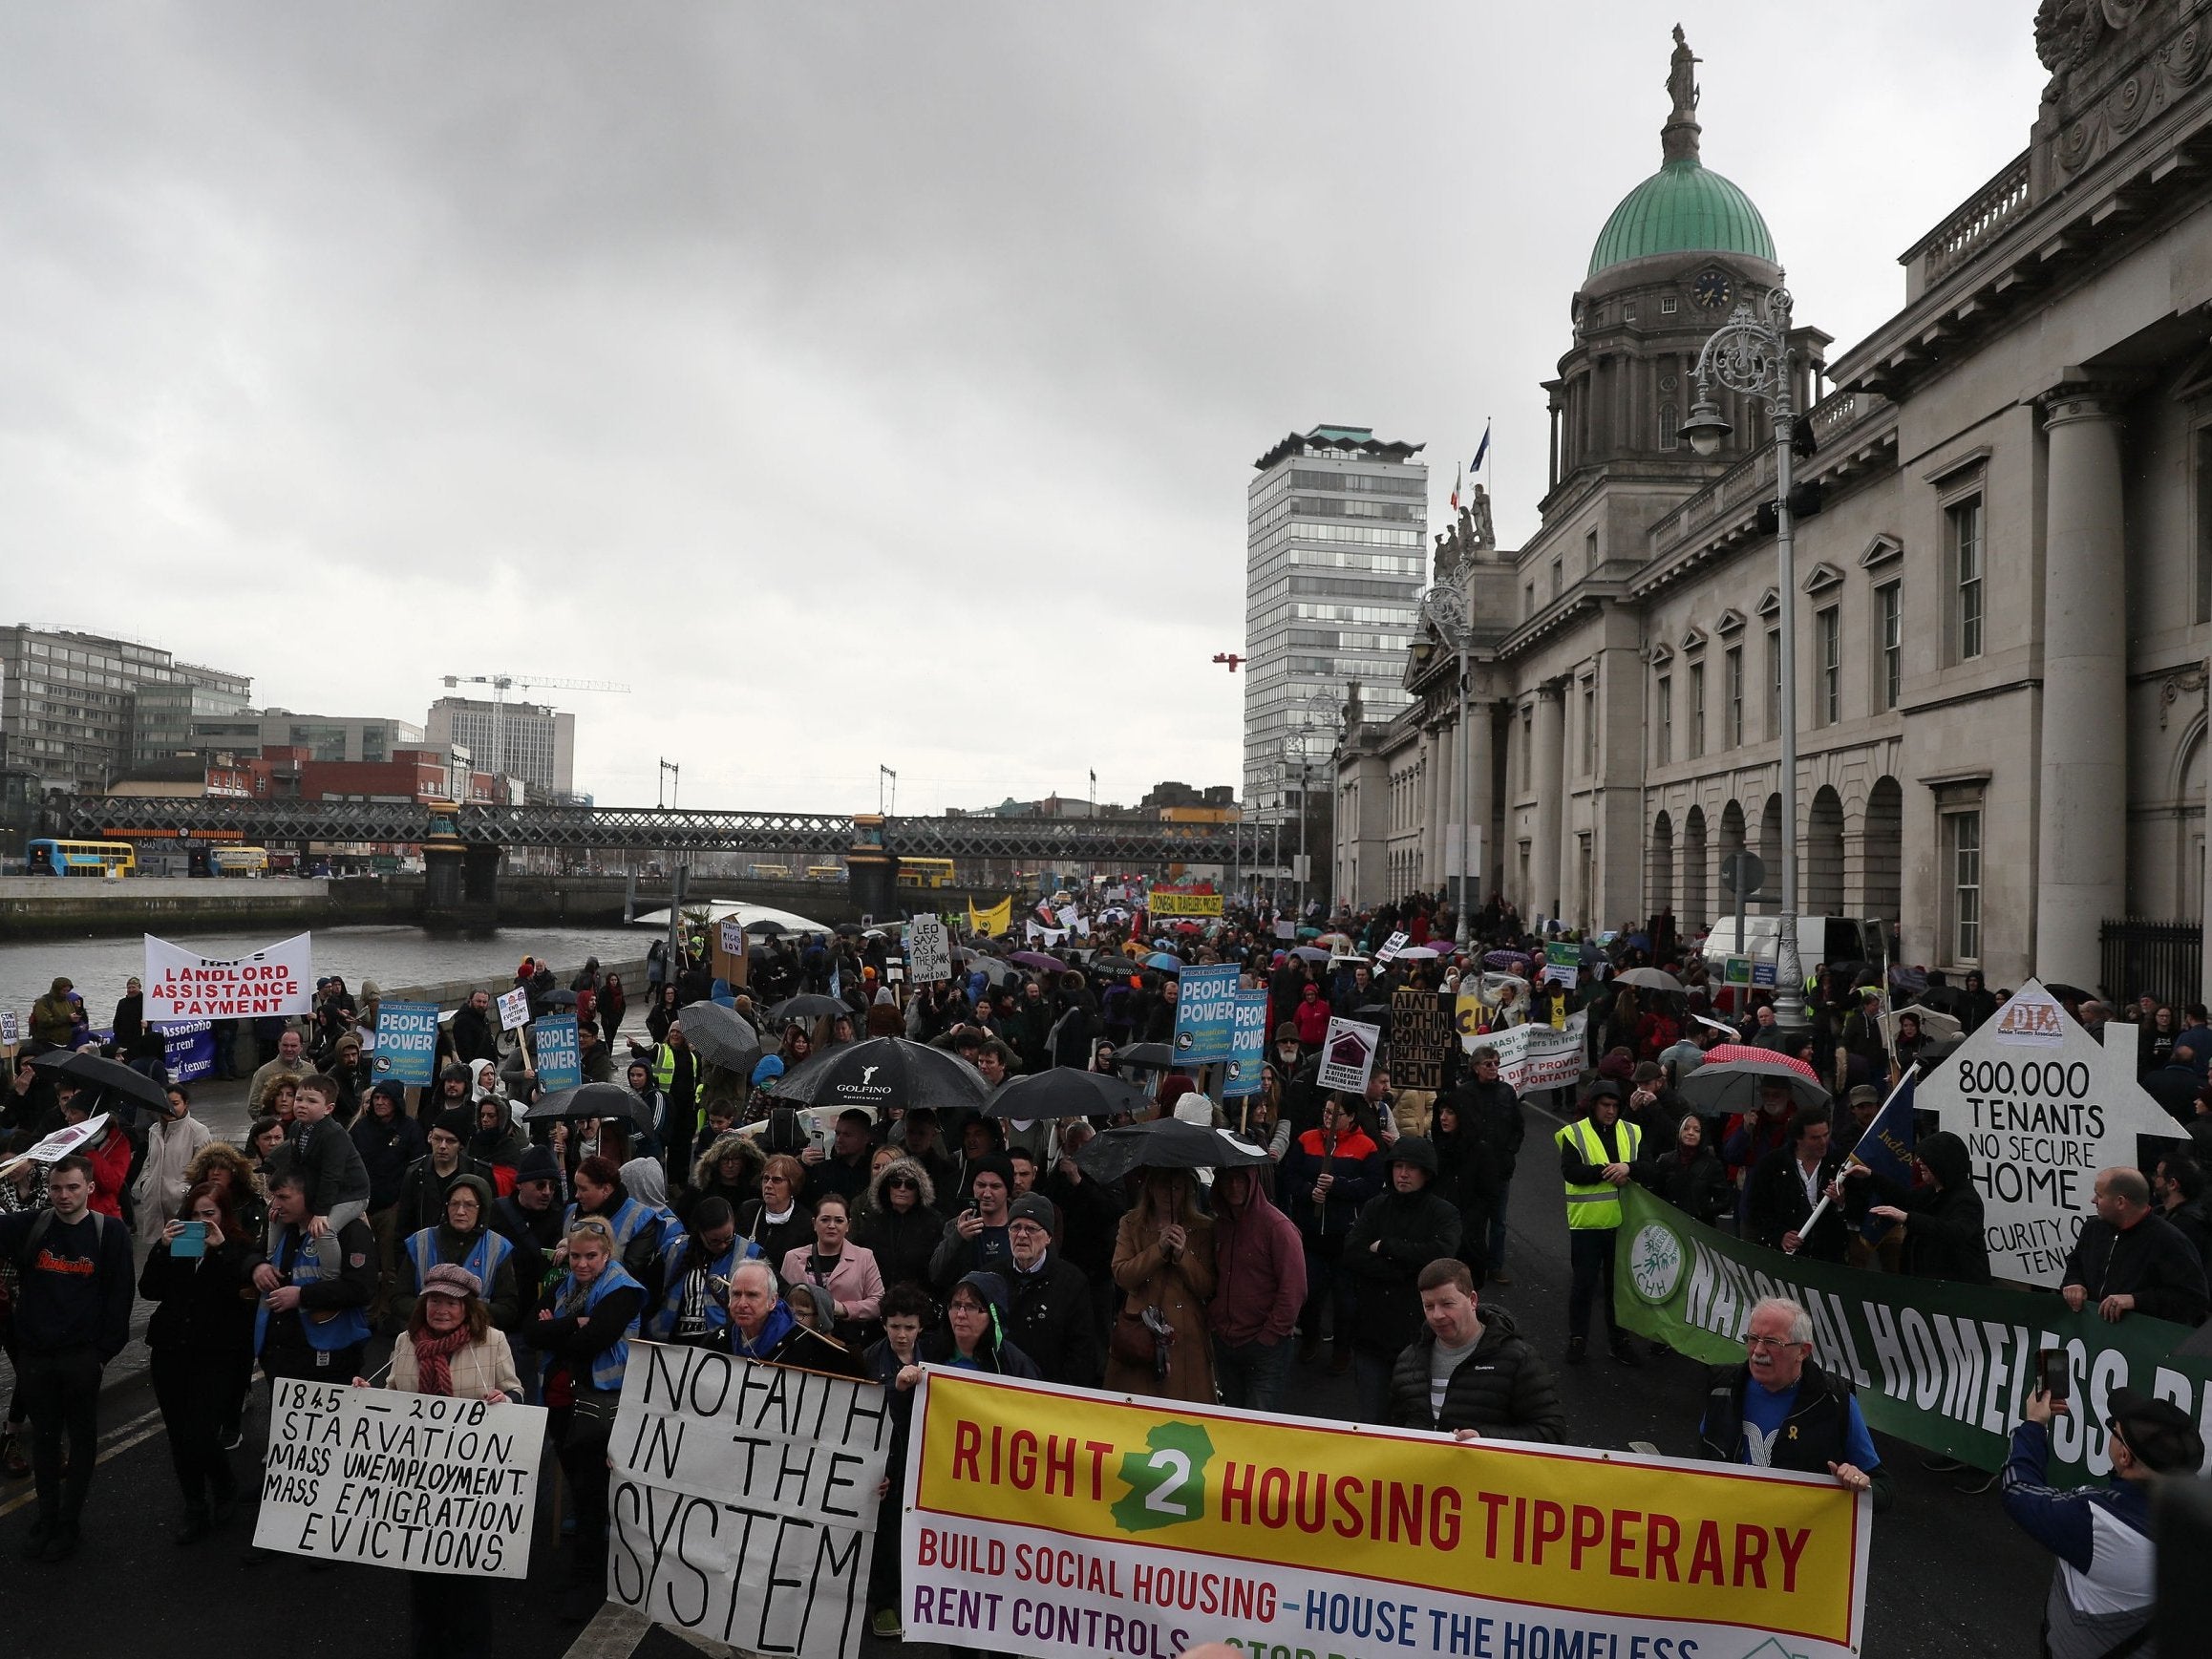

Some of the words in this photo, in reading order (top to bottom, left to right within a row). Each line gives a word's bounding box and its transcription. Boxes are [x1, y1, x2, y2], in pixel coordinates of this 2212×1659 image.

[913, 935, 940, 946] SAYS
[917, 924, 939, 935] LEO
[913, 945, 938, 955] ASK
[915, 956, 930, 967] THE
[930, 953, 950, 965] BANK
[166, 965, 288, 982] LANDLORD
[152, 981, 298, 999] ASSISTANCE
[1181, 979, 1237, 1001] PEOPLE
[173, 998, 283, 1015] PAYMENT
[1180, 1001, 1235, 1024] POWER
[2012, 1004, 2061, 1032] DTA
[379, 1013, 435, 1032] PEOPLE
[1392, 1011, 1449, 1030] NOTHIN
[176, 1037, 195, 1050] rent
[376, 1032, 433, 1051] POWER
[536, 1028, 576, 1050] PEOPLE
[1549, 1037, 1560, 1047] in
[537, 1050, 577, 1071] POWER
[1394, 1046, 1418, 1060] BUT
[1421, 1047, 1444, 1061] THE
[1393, 1060, 1441, 1088] RENT
[1959, 1059, 2090, 1098] 800,000
[837, 1084, 892, 1095] GOLFINO
[1966, 1097, 2105, 1139] TENANTS
[1968, 1133, 2000, 1159] NO
[2009, 1136, 2096, 1169] SECURE
[1969, 1161, 2081, 1211] HOME
[1985, 1218, 2062, 1254] CURITY
[643, 1345, 733, 1417] NO
[735, 1362, 890, 1452] FAITH
[1861, 1301, 2129, 1477] HOMELSS
[279, 1382, 345, 1413] 1845
[409, 1399, 487, 1426] 2018
[267, 1442, 332, 1477] MASS
[628, 1414, 686, 1479] IN
[733, 1435, 864, 1518] THE
[263, 1474, 320, 1506] MASS
[952, 1419, 1114, 1501] RIGHT
[1145, 1448, 1191, 1517] 2
[1222, 1460, 1462, 1552] HOUSING
[1478, 1491, 1812, 1594] TIPPERARY
[613, 1481, 863, 1659] SYSTEM
[918, 1528, 1006, 1577] BUILD
[1015, 1542, 1123, 1599] SOCIAL
[1133, 1563, 1277, 1624] HOUSING
[1305, 1588, 1419, 1647] HOUSE
[1428, 1609, 1496, 1658] THE
[1504, 1622, 1699, 1659] HOMELESS
[913, 1585, 1004, 1631] RENT
[1012, 1597, 1191, 1659] CONTROLS
